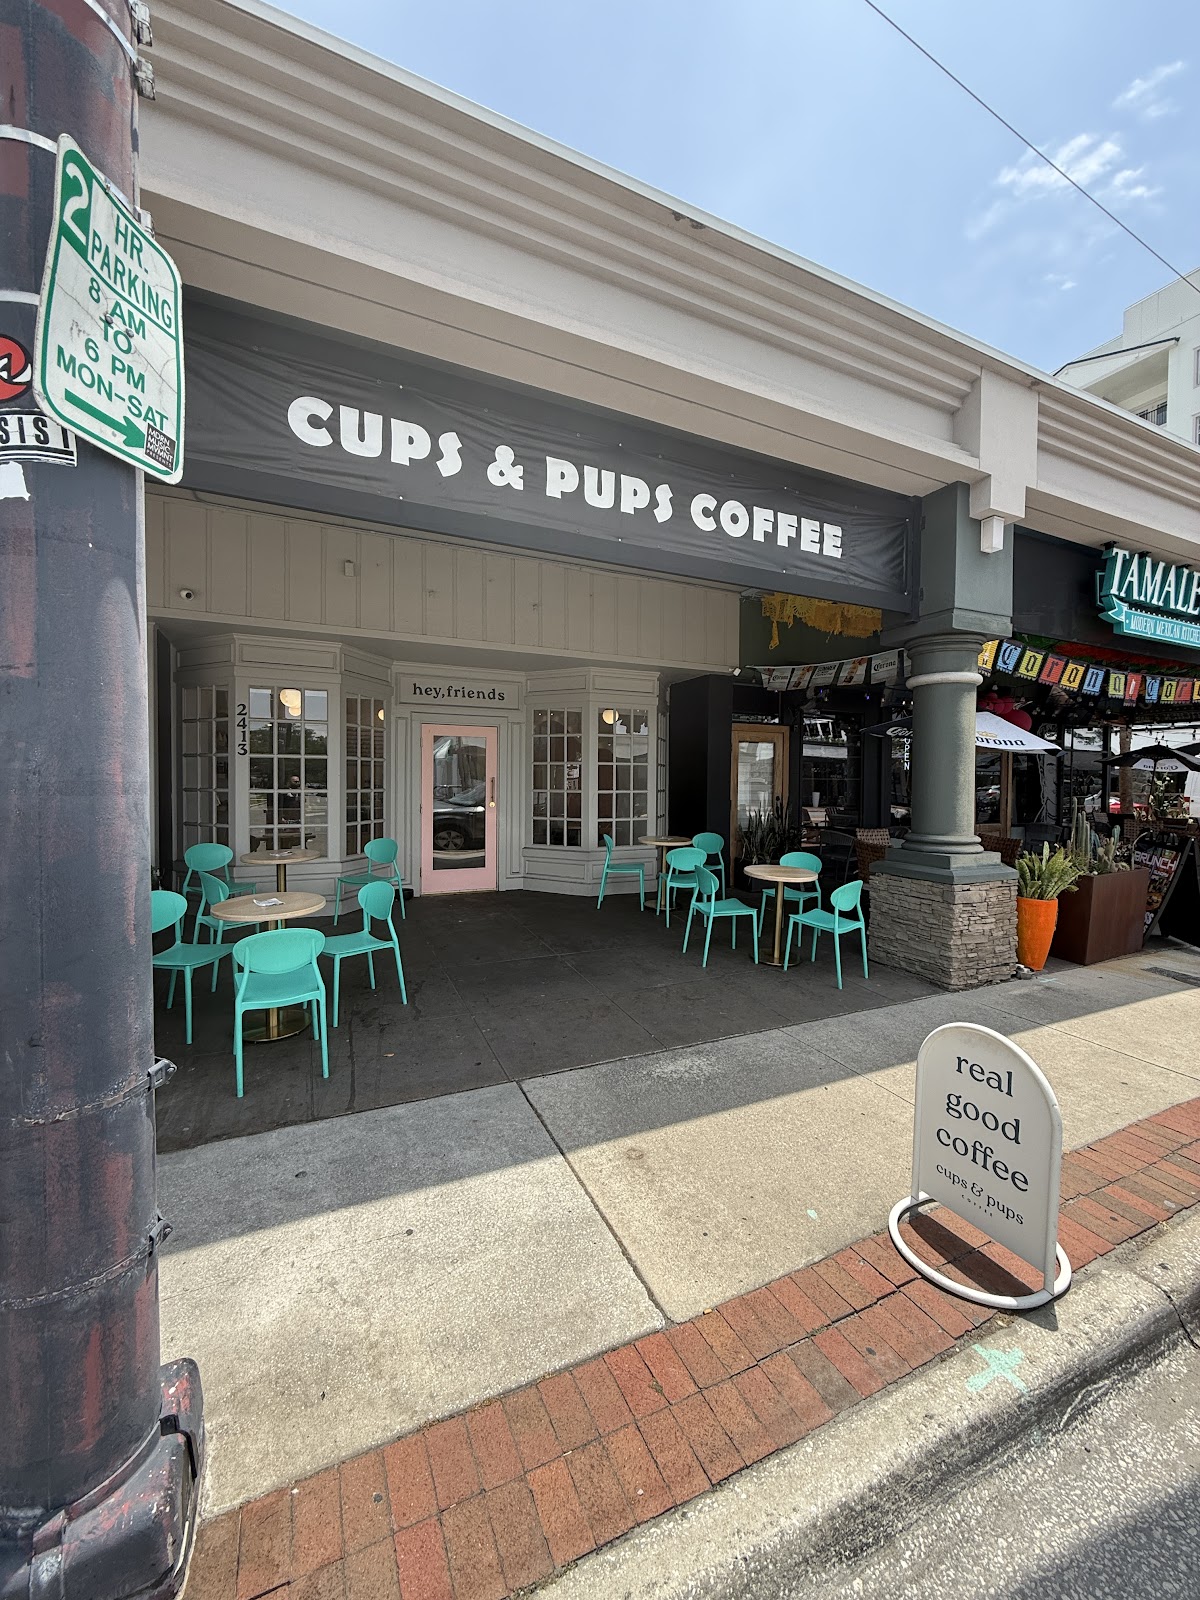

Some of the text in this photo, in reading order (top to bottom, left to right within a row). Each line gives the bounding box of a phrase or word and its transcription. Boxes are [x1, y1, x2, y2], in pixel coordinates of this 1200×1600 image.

[64, 162, 89, 246] 2
[115, 214, 150, 274] HR.
[92, 229, 172, 329] PARKING
[89, 276, 146, 340] 8 AM
[99, 315, 132, 353] TO
[57, 344, 168, 432] MON-SAT
[85, 337, 145, 393] 6 PM
[287, 396, 842, 559] CUPS & PUPS COFFEE
[1130, 615, 1155, 634] MODERN
[1156, 620, 1181, 638] MEXICAN
[873, 659, 897, 672] Corona
[1002, 645, 1121, 693] Corona
[236, 703, 248, 756] 2413
[975, 736, 1026, 746] orona
[956, 1056, 1014, 1097] real
[946, 1093, 1021, 1145] good
[936, 1128, 1029, 1192] coffee
[936, 1164, 967, 1190] cups
[971, 1183, 984, 1197] &
[987, 1194, 1024, 1225] pups
